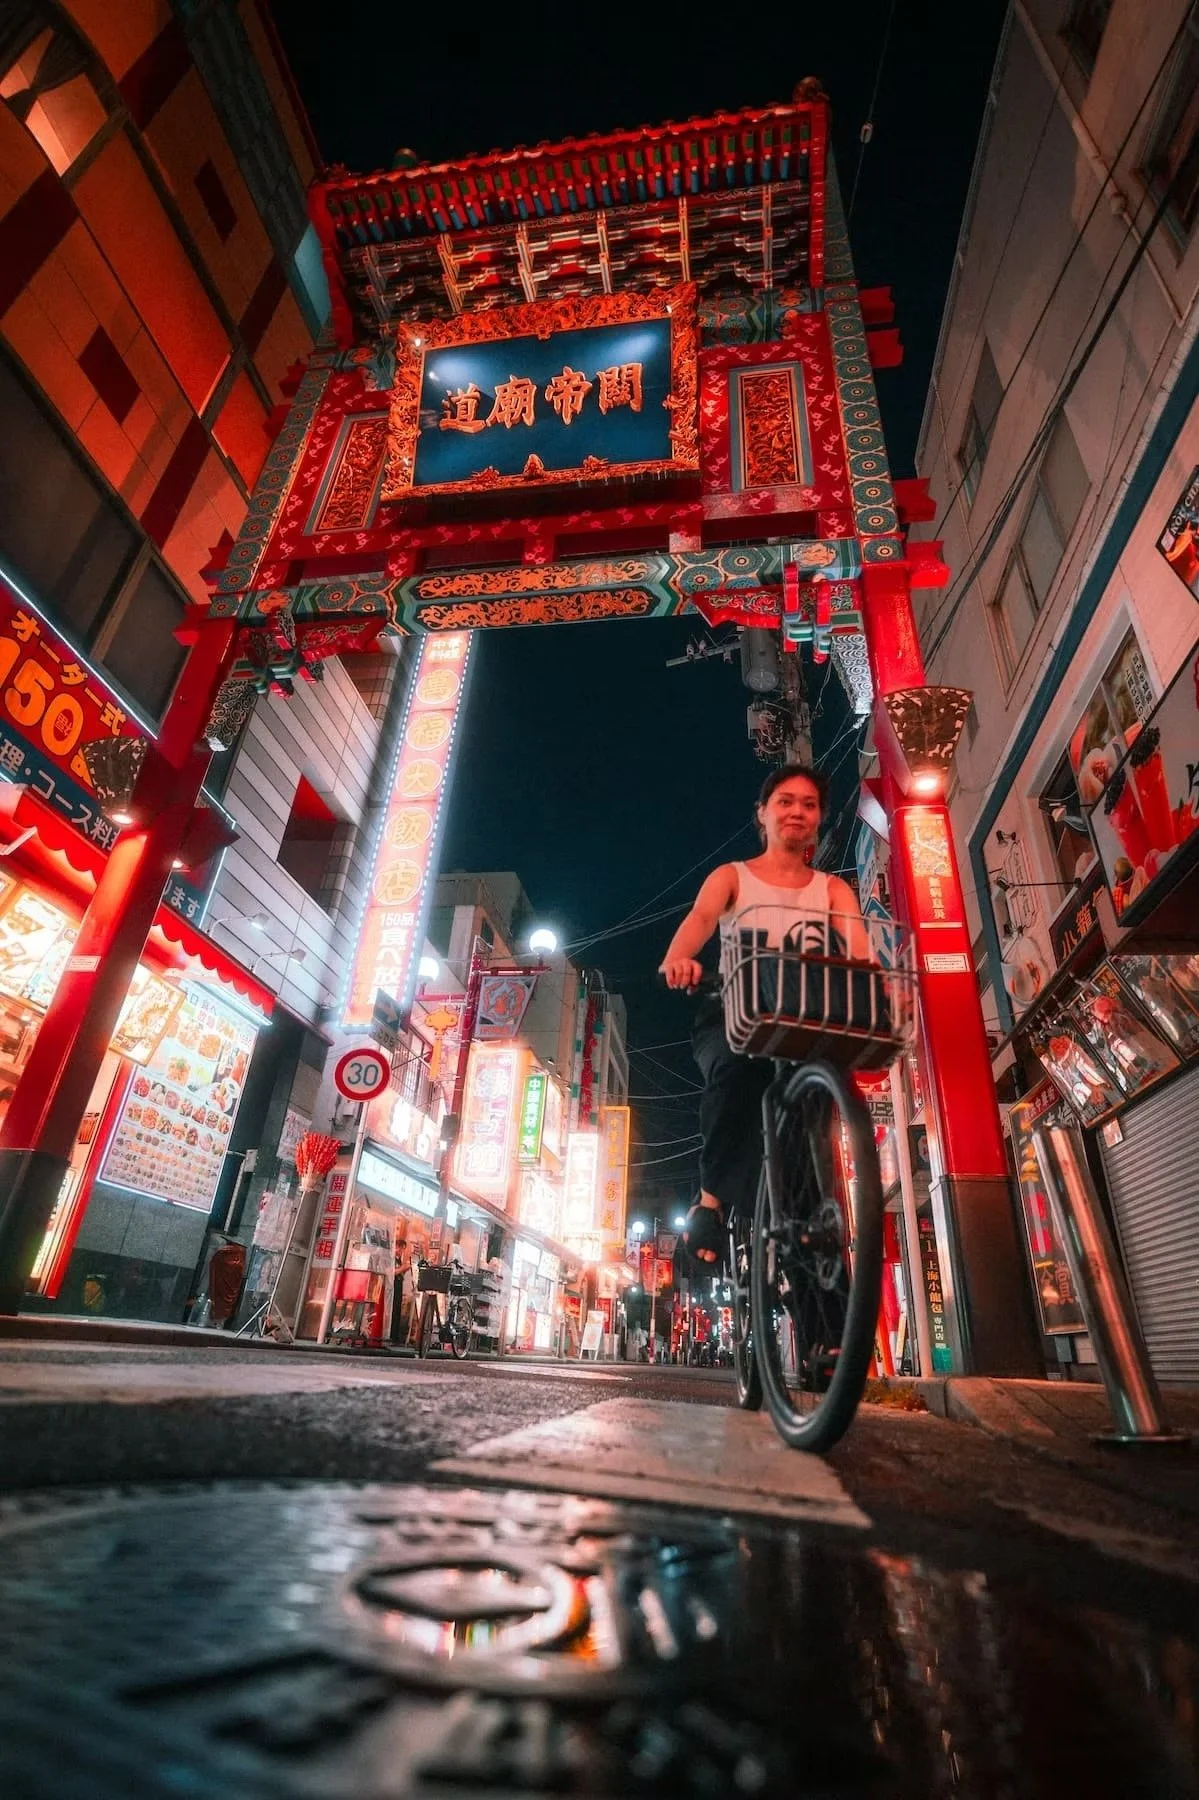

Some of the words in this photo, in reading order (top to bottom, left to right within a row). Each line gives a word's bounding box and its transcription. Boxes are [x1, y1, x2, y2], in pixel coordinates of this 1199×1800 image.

[11, 610, 127, 736] オーダー式
[0, 738, 120, 851] 理・コース料
[1062, 885, 1105, 960] 小籠
[347, 1062, 378, 1086] 30
